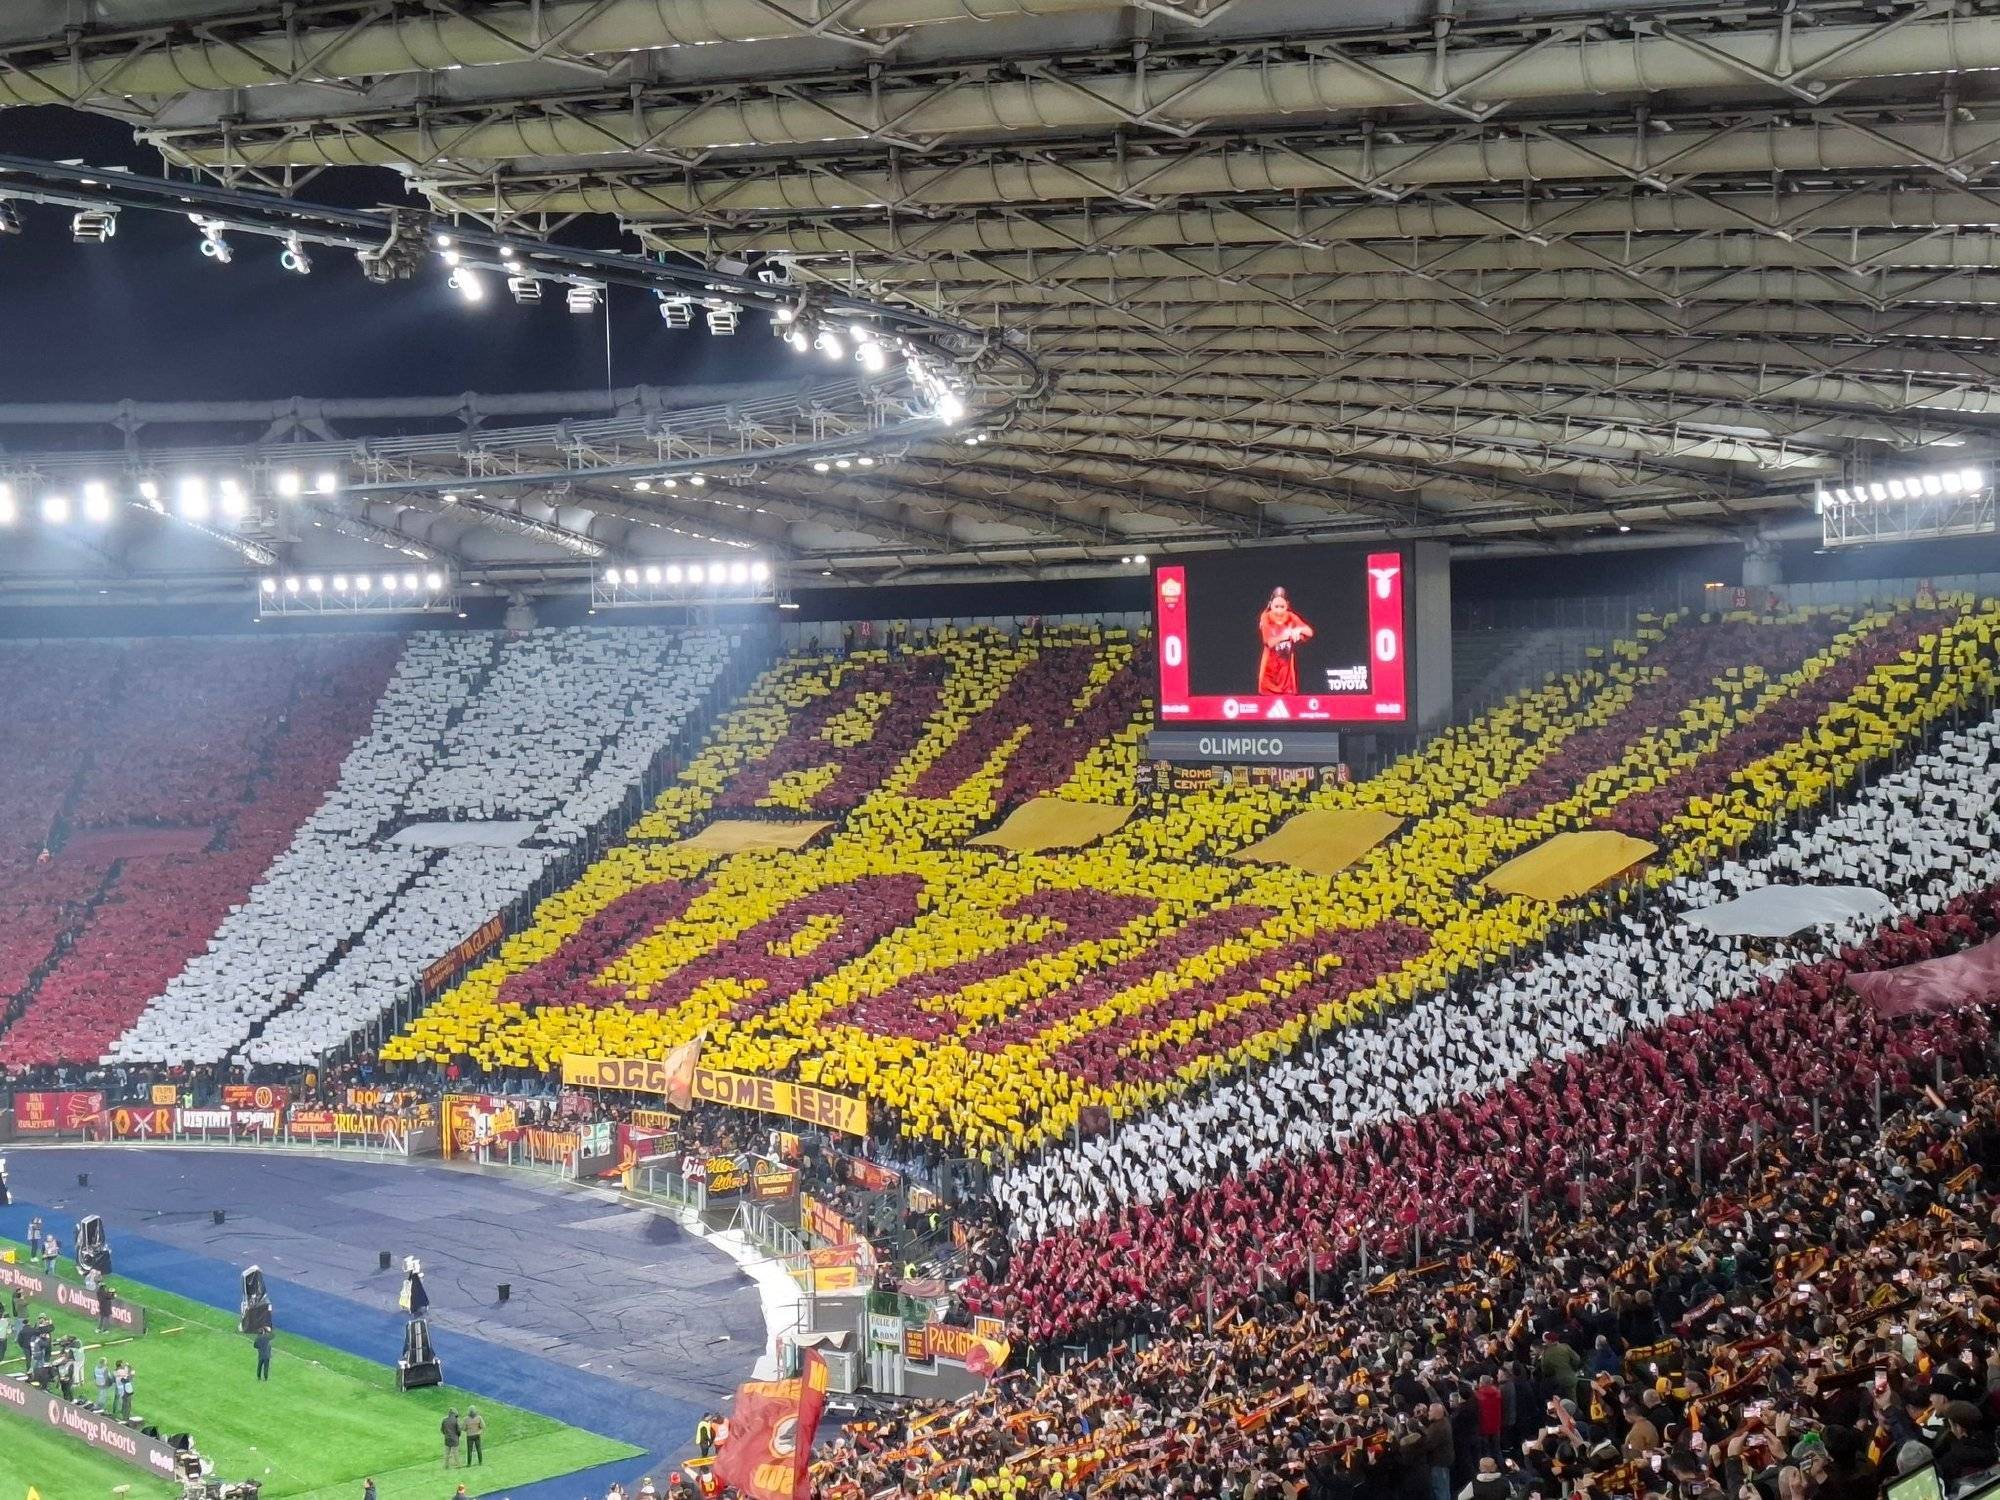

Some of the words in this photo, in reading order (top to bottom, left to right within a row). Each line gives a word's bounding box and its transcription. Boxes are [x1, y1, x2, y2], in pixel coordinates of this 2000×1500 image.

[1165, 635, 1182, 666] 0
[1376, 628, 1396, 662] 0
[1328, 679, 1368, 690] TOYOTA
[1199, 737, 1283, 756] OLIMPICO
[1181, 769, 1212, 780] ROMA
[696, 1072, 775, 1109] COME
[14, 1269, 42, 1292] Resorts
[62, 1406, 99, 1441] Auberge
[100, 1422, 137, 1456] Resorts
